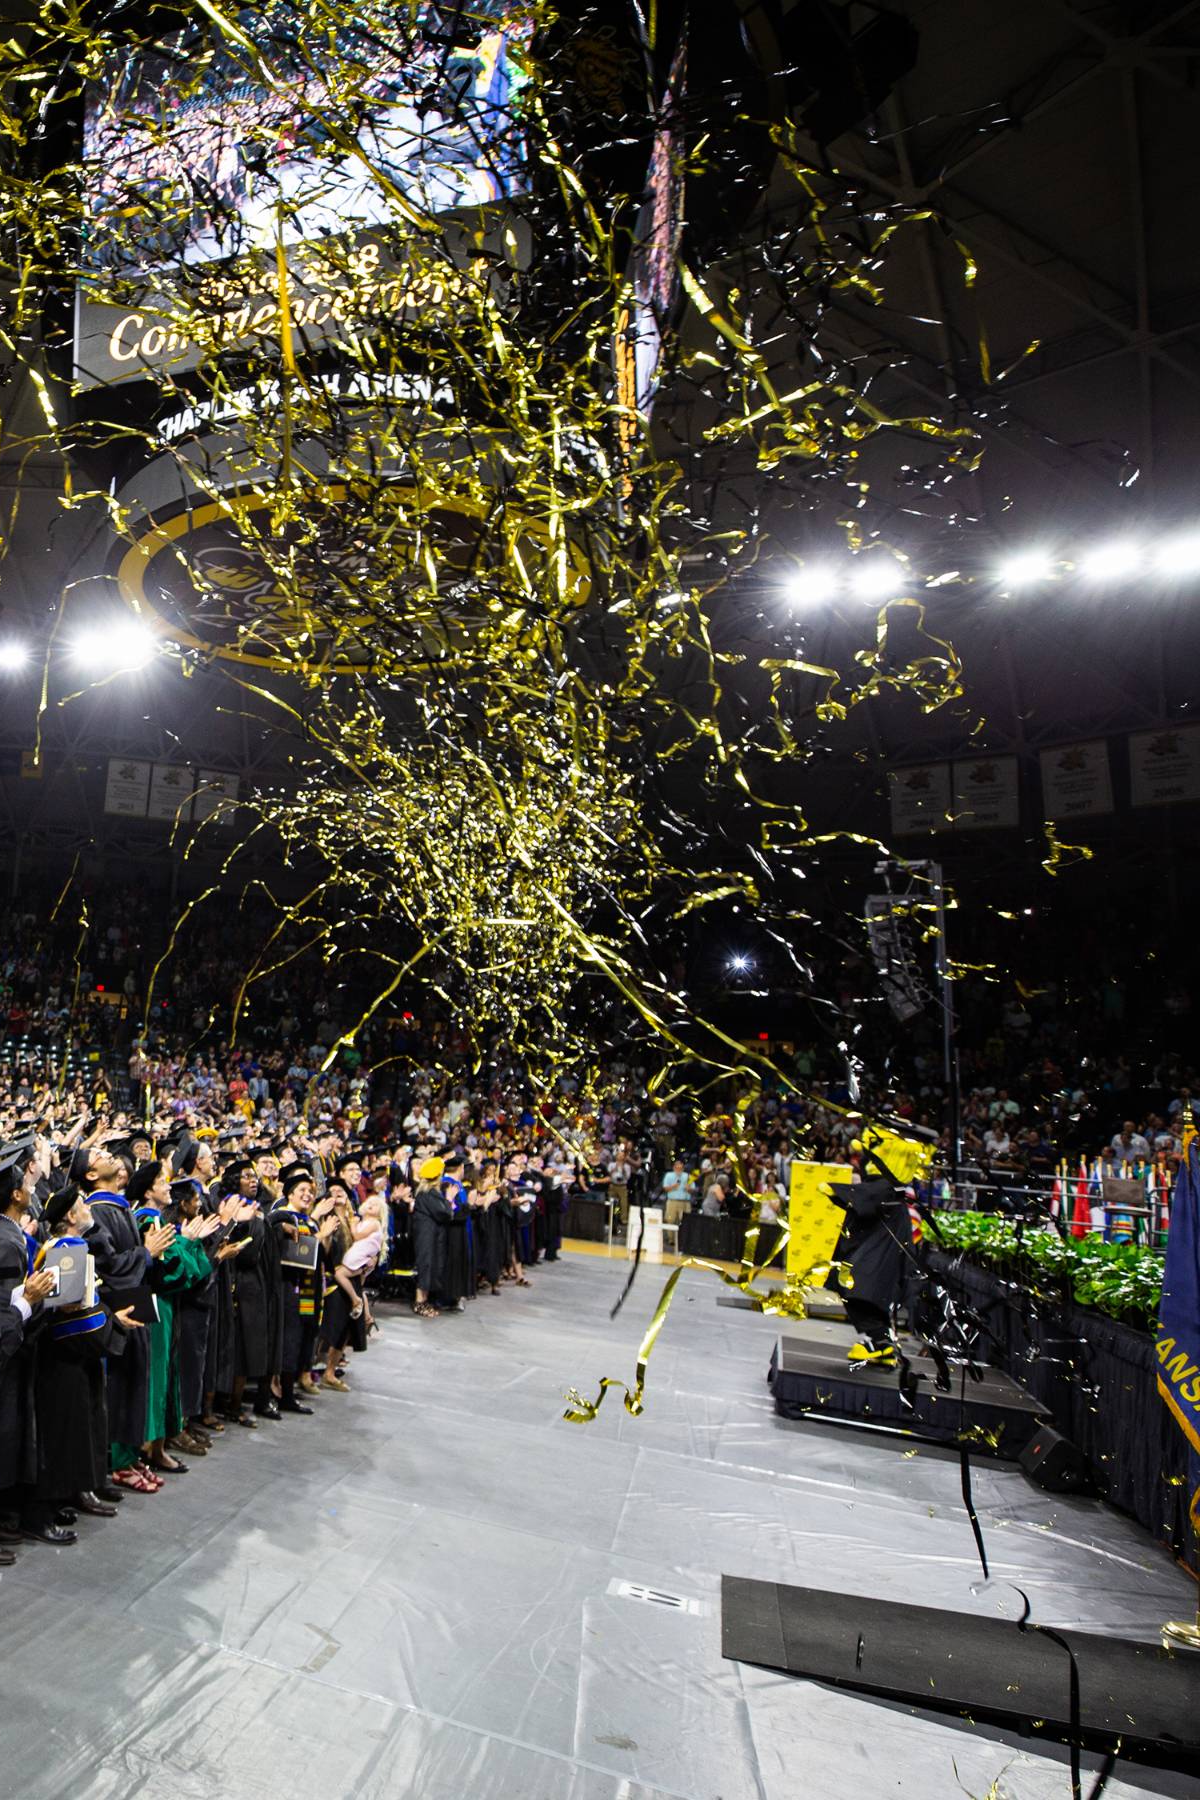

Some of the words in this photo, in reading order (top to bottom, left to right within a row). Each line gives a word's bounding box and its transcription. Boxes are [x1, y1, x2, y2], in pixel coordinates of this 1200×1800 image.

[258, 373, 340, 407] KH
[347, 371, 455, 404] ARENA
[1154, 1322, 1200, 1412] ANS
